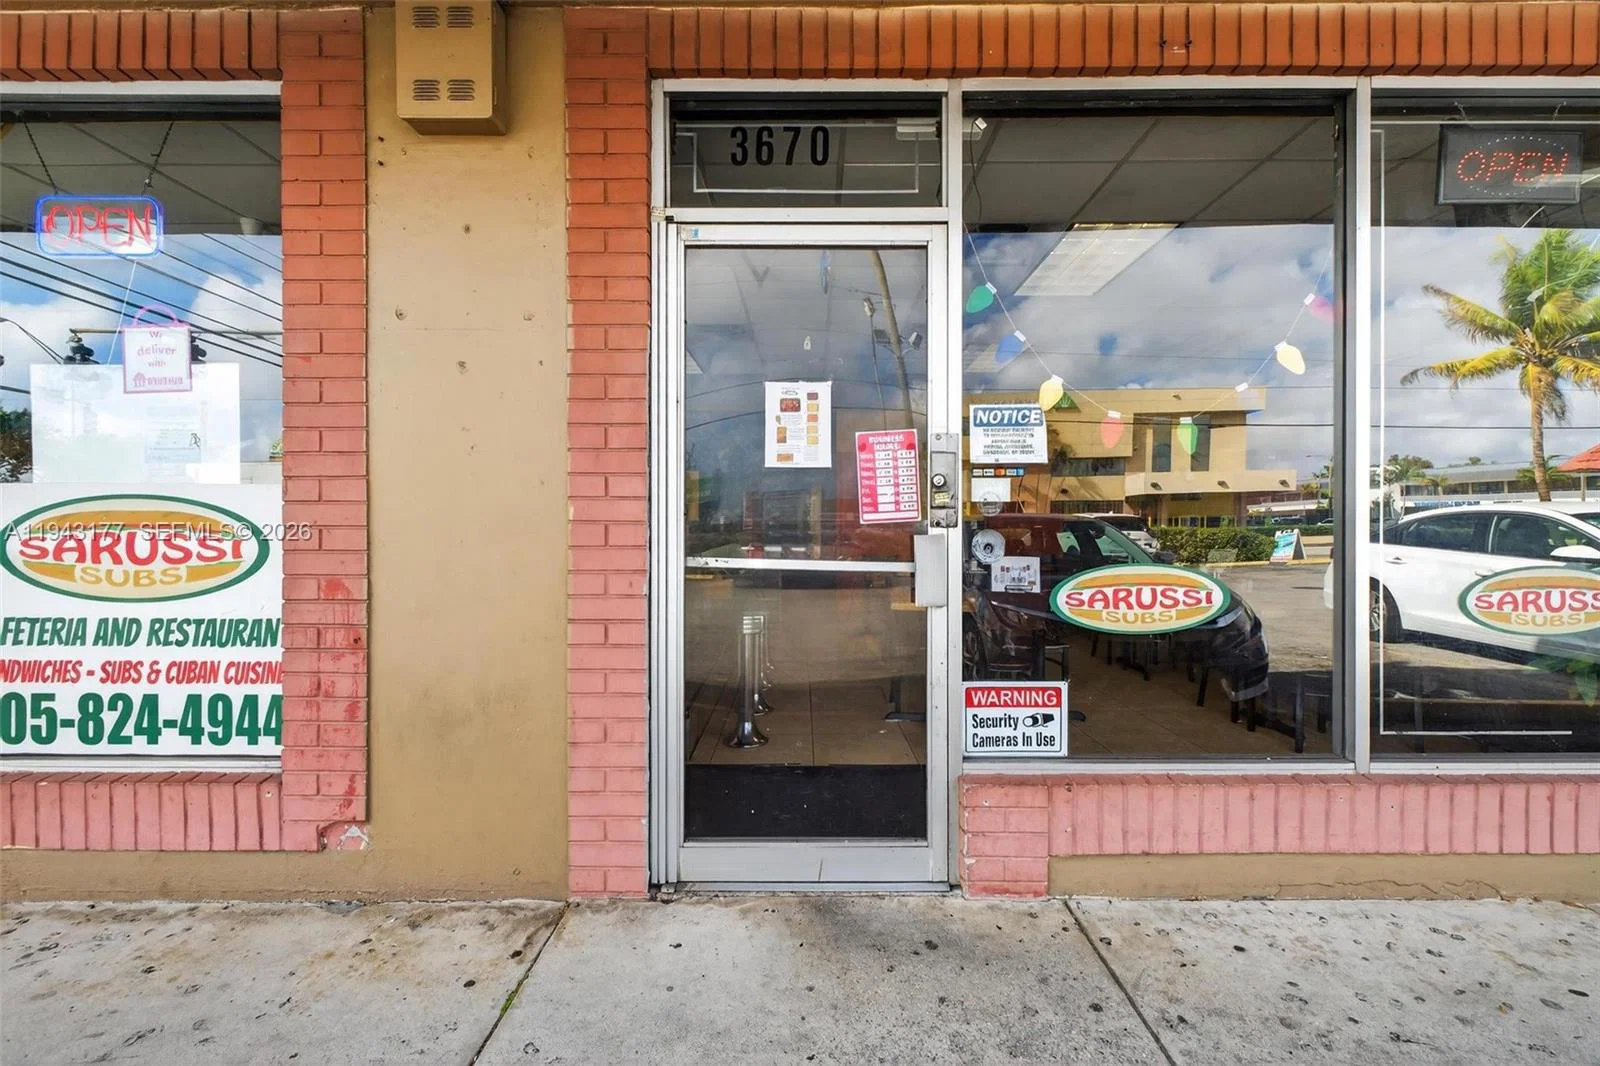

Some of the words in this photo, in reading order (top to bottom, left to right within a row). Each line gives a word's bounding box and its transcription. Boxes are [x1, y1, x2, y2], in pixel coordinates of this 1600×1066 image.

[730, 125, 830, 167] 3670
[1456, 150, 1569, 182] OPEN
[43, 204, 152, 248] OPEN
[975, 409, 1041, 424] NOTICE
[18, 531, 244, 567] SARUSSI
[79, 565, 184, 588] SUBS
[1065, 587, 1213, 611] SARUSSI
[1105, 610, 1174, 625] SUBS
[1513, 612, 1582, 627] SUBS
[1, 617, 88, 647] FETERIA
[92, 617, 142, 647] AND
[99, 660, 144, 684] SUBS
[147, 660, 162, 684] &
[165, 660, 221, 685] CUBAN
[971, 690, 1057, 706] WARNING
[0, 691, 282, 746] 05-824-4944
[972, 712, 1019, 731] Security
[972, 732, 1019, 748] Cameras
[1022, 732, 1033, 747] In
[1036, 732, 1056, 747] Use
